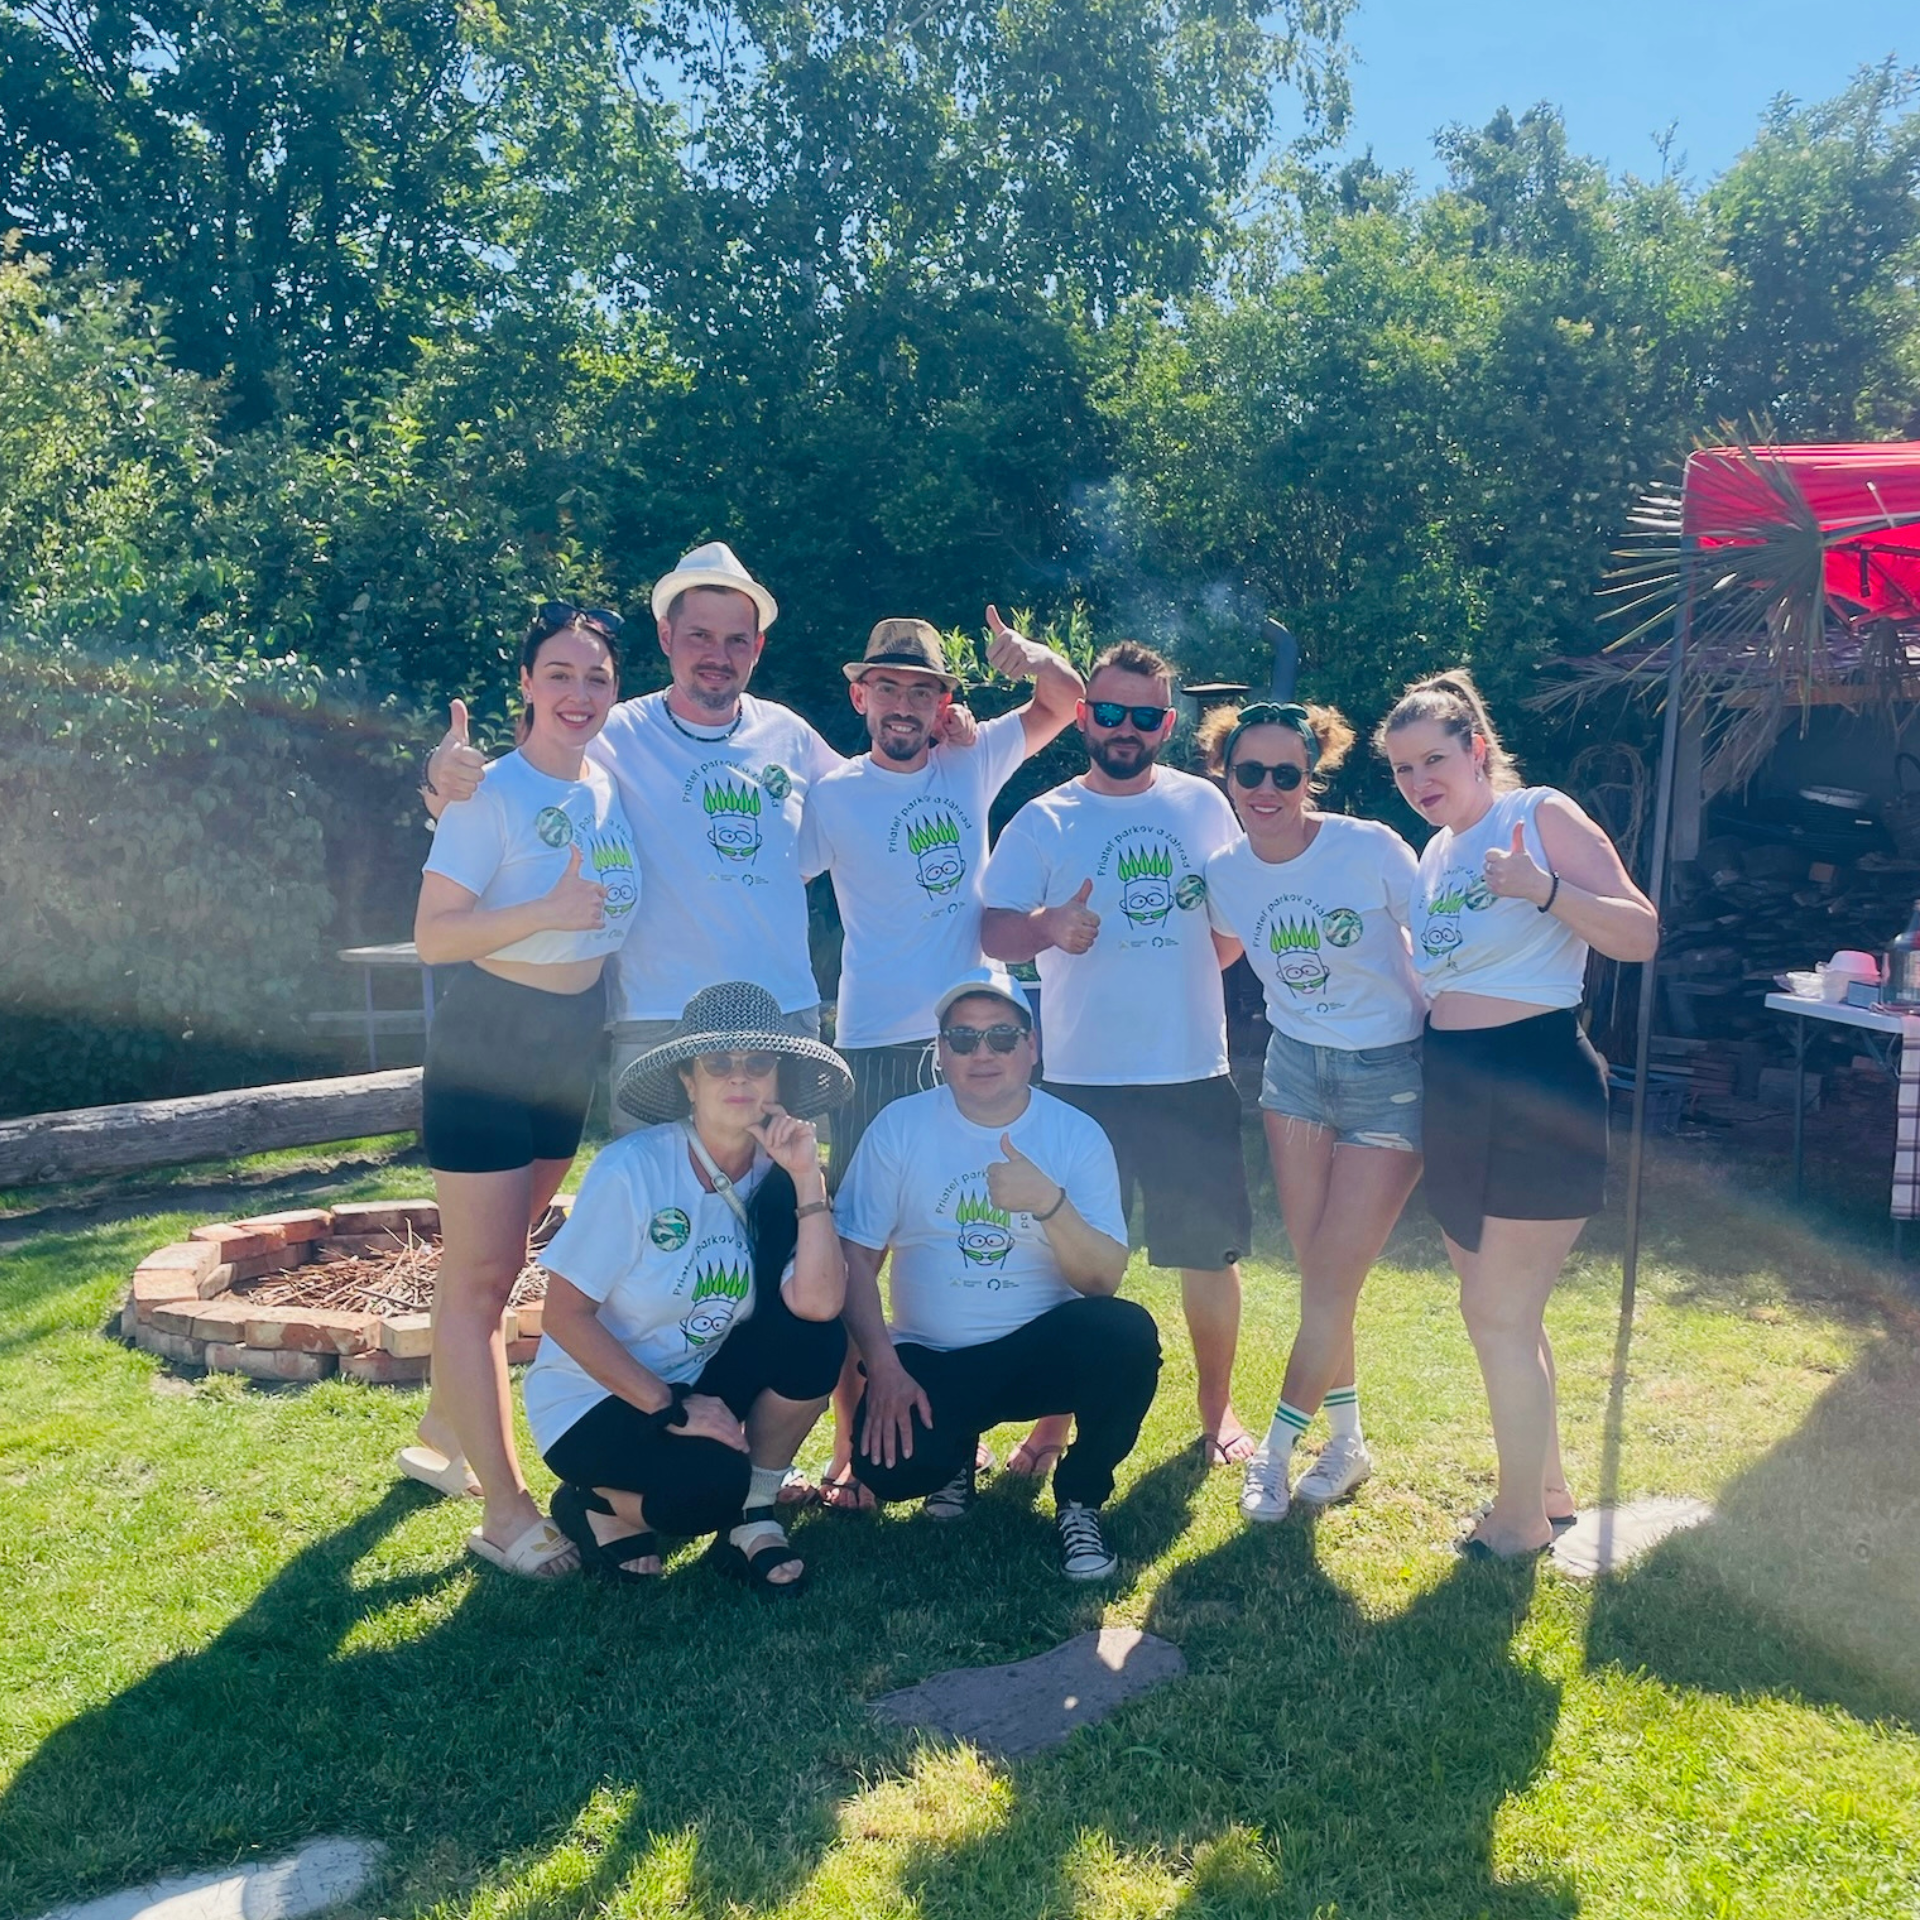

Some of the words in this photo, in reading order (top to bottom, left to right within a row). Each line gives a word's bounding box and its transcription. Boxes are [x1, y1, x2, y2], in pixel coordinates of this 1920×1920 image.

[1114, 825, 1154, 844] parkov
[1156, 828, 1165, 836] a
[1267, 893, 1303, 913] parkov
[695, 1234, 734, 1255] parkov
[736, 1241, 743, 1249] a
